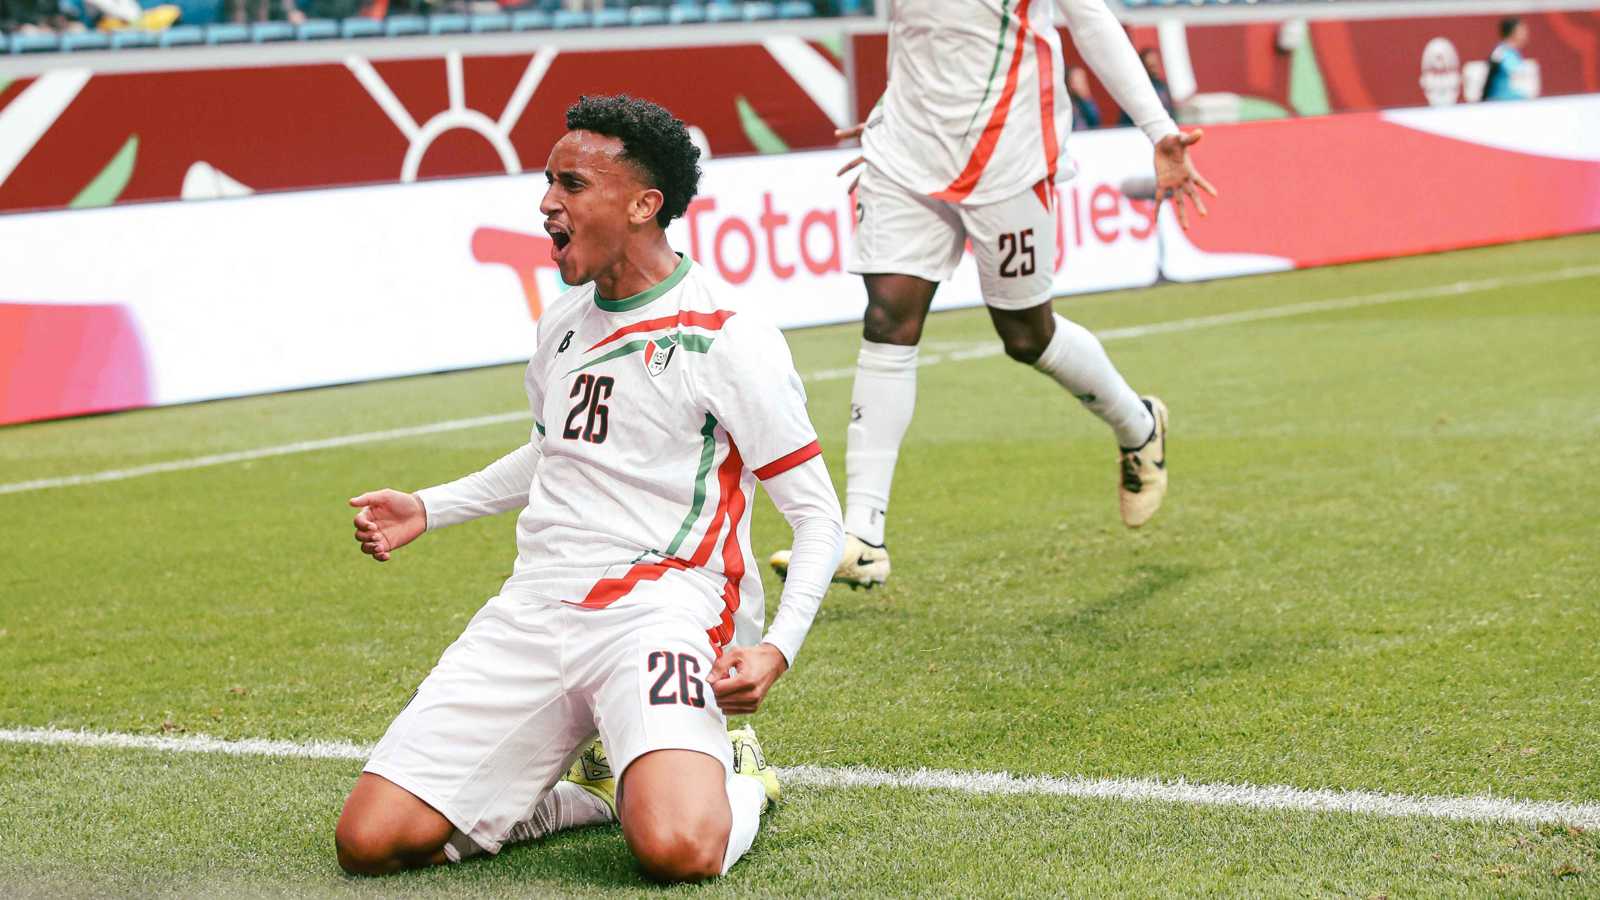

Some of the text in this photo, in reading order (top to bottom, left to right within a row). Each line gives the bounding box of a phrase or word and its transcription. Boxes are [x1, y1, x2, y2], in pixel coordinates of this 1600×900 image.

[998, 227, 1036, 278] 25
[562, 373, 615, 445] 26
[647, 651, 706, 709] 26
